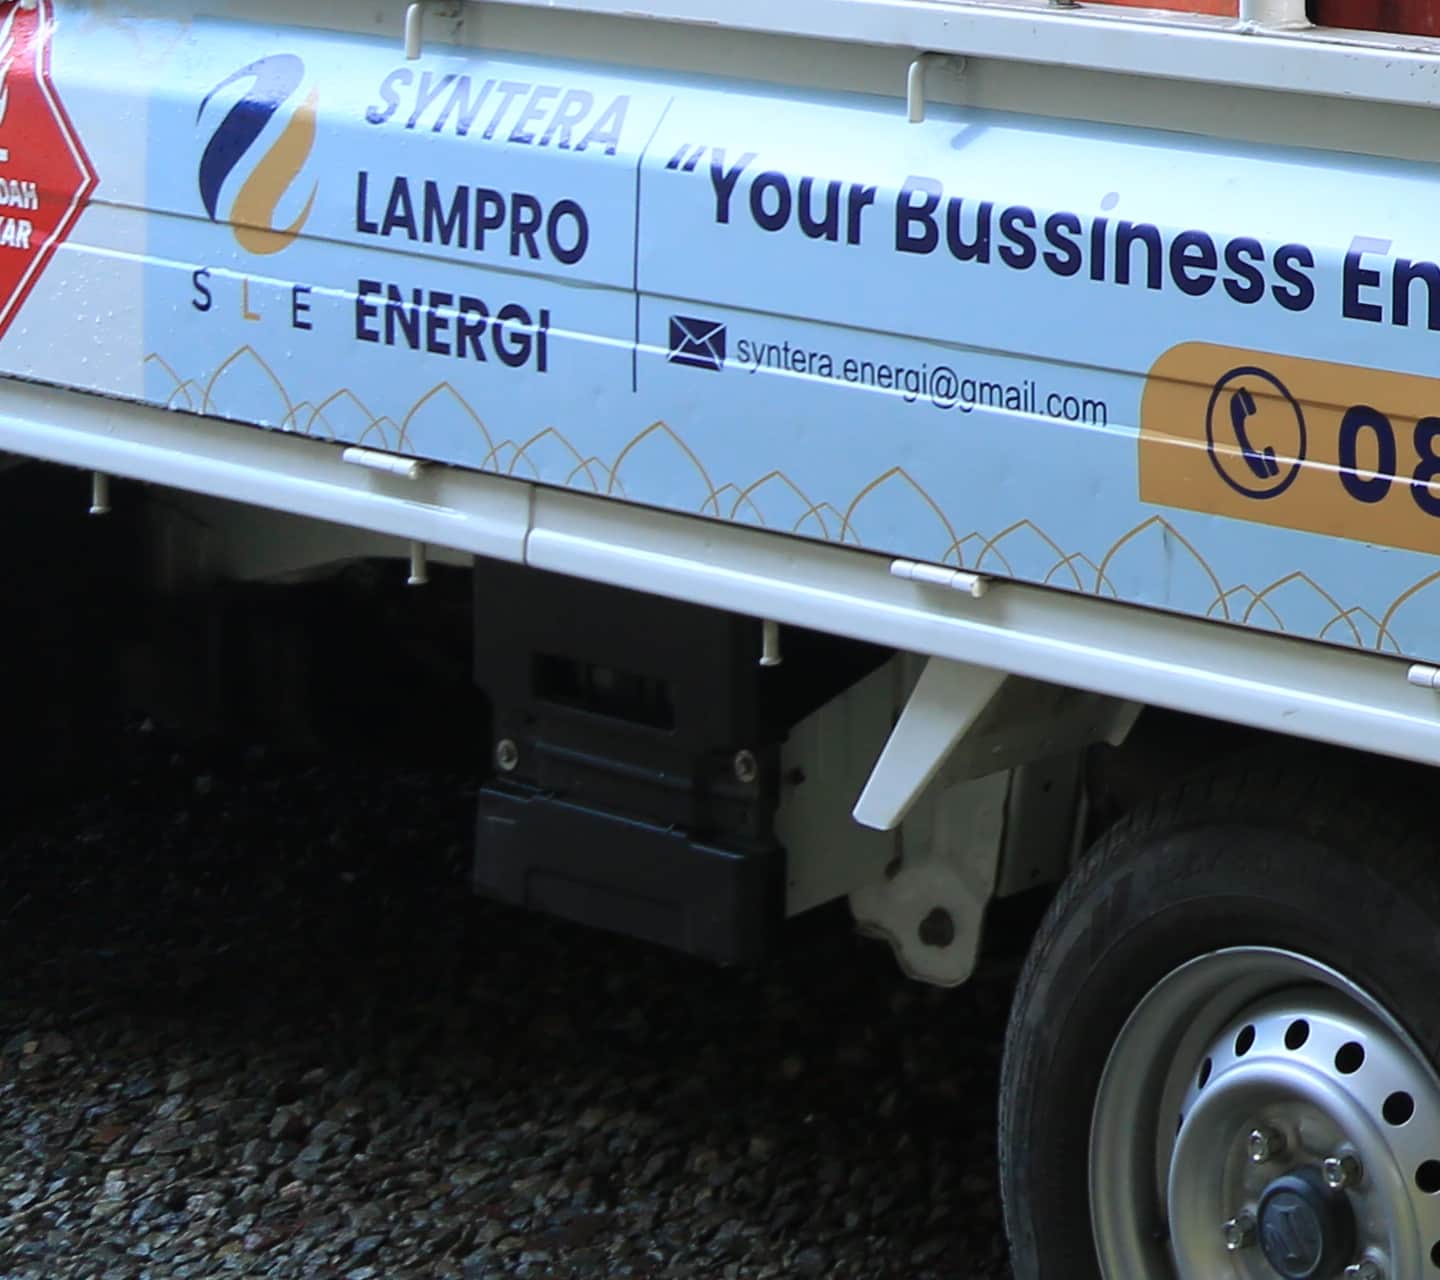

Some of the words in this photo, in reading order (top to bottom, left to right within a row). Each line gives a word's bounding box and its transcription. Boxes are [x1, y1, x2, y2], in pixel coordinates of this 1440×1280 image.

[365, 67, 632, 156] SYNTERA
[355, 171, 590, 266] LAMPRO
[894, 175, 1316, 312] Bussiness
[355, 278, 551, 373] ENERGI
[735, 334, 1109, 429] syntera.energi@gmail.com
